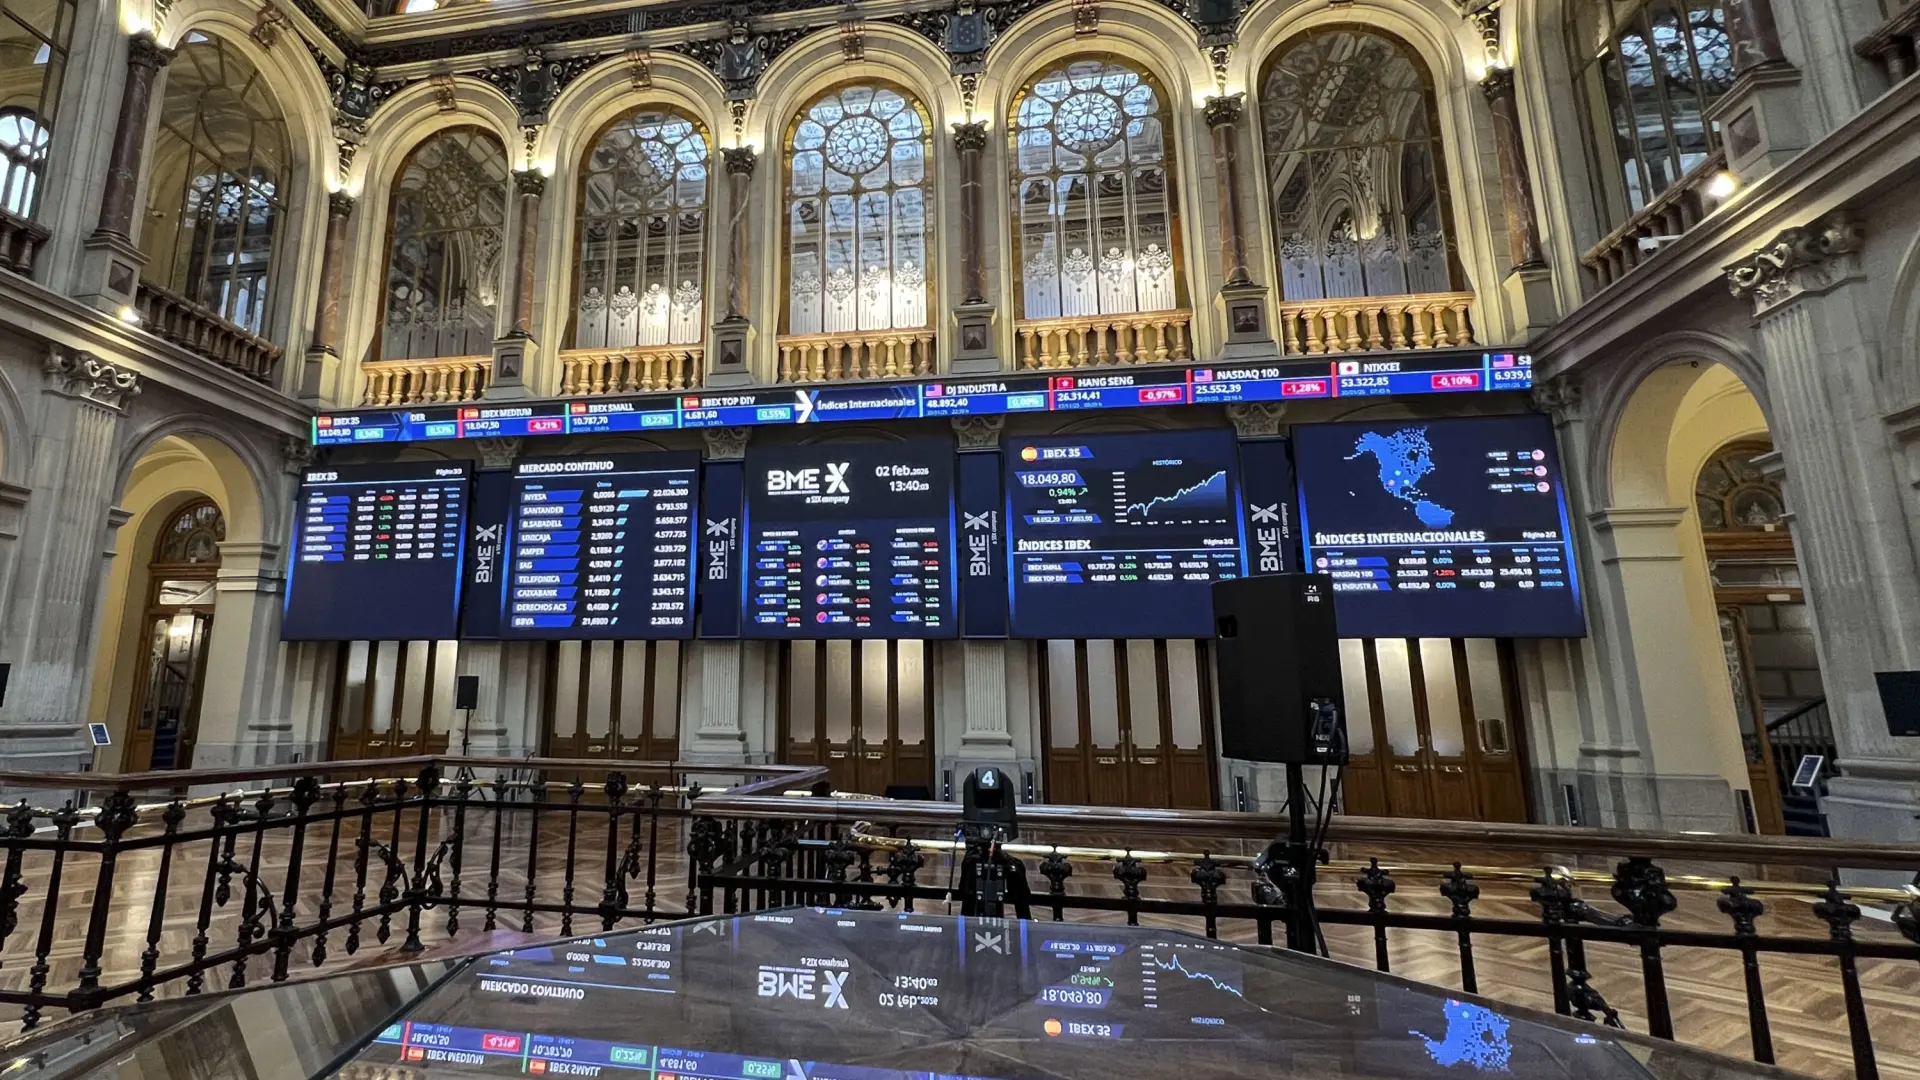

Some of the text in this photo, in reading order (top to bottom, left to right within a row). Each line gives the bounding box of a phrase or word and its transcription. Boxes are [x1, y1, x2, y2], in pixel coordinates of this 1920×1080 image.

[1364, 362, 1400, 372] NIKKEI
[1217, 368, 1279, 380] NASDAQ 100
[1078, 376, 1134, 387] HANG SENG
[1341, 377, 1389, 388] 53.322,85
[1438, 376, 1472, 387] -0,10%
[946, 386, 956, 396] DJ
[957, 384, 998, 394] INDUSTR
[1195, 384, 1242, 394] 25.552,39
[1287, 384, 1320, 394] -1,28%
[740, 396, 756, 405] DIV
[1058, 392, 1100, 402] 26.314,41
[1144, 390, 1176, 400] -0,97%
[608, 403, 634, 412] SMALL
[818, 398, 916, 410] Índices Internacionales
[926, 399, 968, 409] 48.892,40
[500, 408, 532, 417] MEDIUM
[685, 411, 717, 420] 4.681,60
[573, 416, 608, 425] 10.787,70
[1043, 448, 1080, 458] IBEX 35
[519, 461, 614, 473] MERCADO CONTINUO
[875, 466, 890, 477] 02
[768, 468, 820, 490] BME
[1021, 473, 1076, 485] 18.049,80
[1049, 488, 1076, 497] 0,94%
[523, 506, 564, 515] SANTANDER
[521, 534, 551, 542] UNICAJA
[1315, 531, 1485, 545] ÍNDICES INTERNACIONALES
[1018, 538, 1091, 551] ÍNDICES IBEX
[1257, 528, 1279, 571] BME
[709, 540, 724, 579] BME
[969, 535, 986, 576] BME
[475, 546, 491, 583] BME
[982, 771, 994, 787] 4
